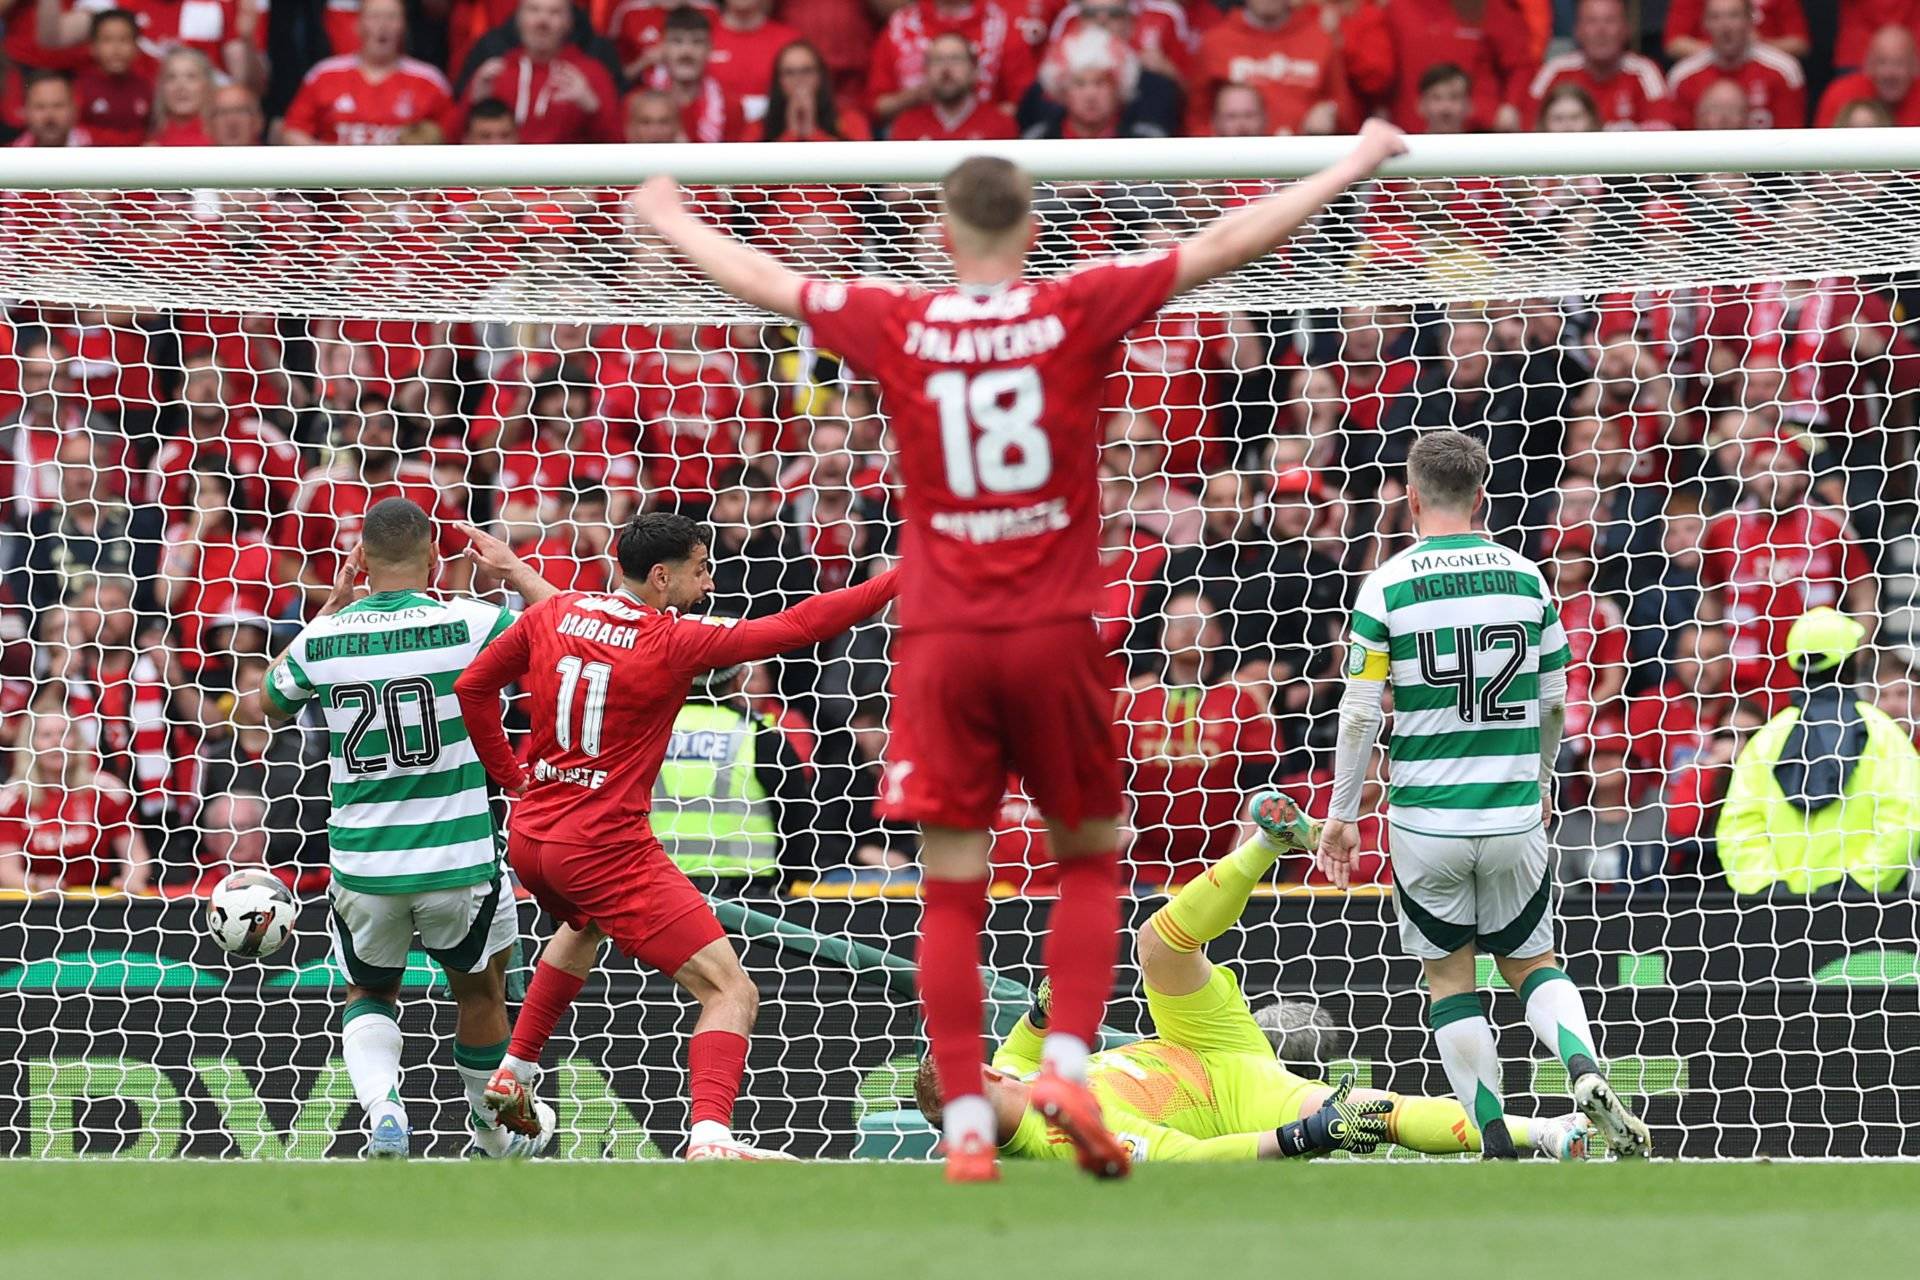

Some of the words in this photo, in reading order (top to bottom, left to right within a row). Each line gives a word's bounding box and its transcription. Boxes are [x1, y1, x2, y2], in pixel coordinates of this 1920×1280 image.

[924, 364, 1052, 499] 18
[1411, 552, 1511, 573] MAGNERS
[306, 621, 470, 661] CARTER-VICKERS
[336, 606, 427, 626] MAGNERS
[555, 655, 612, 758] 11
[1416, 621, 1528, 723] 42
[330, 675, 441, 774] 20
[666, 731, 728, 759] OLICE
